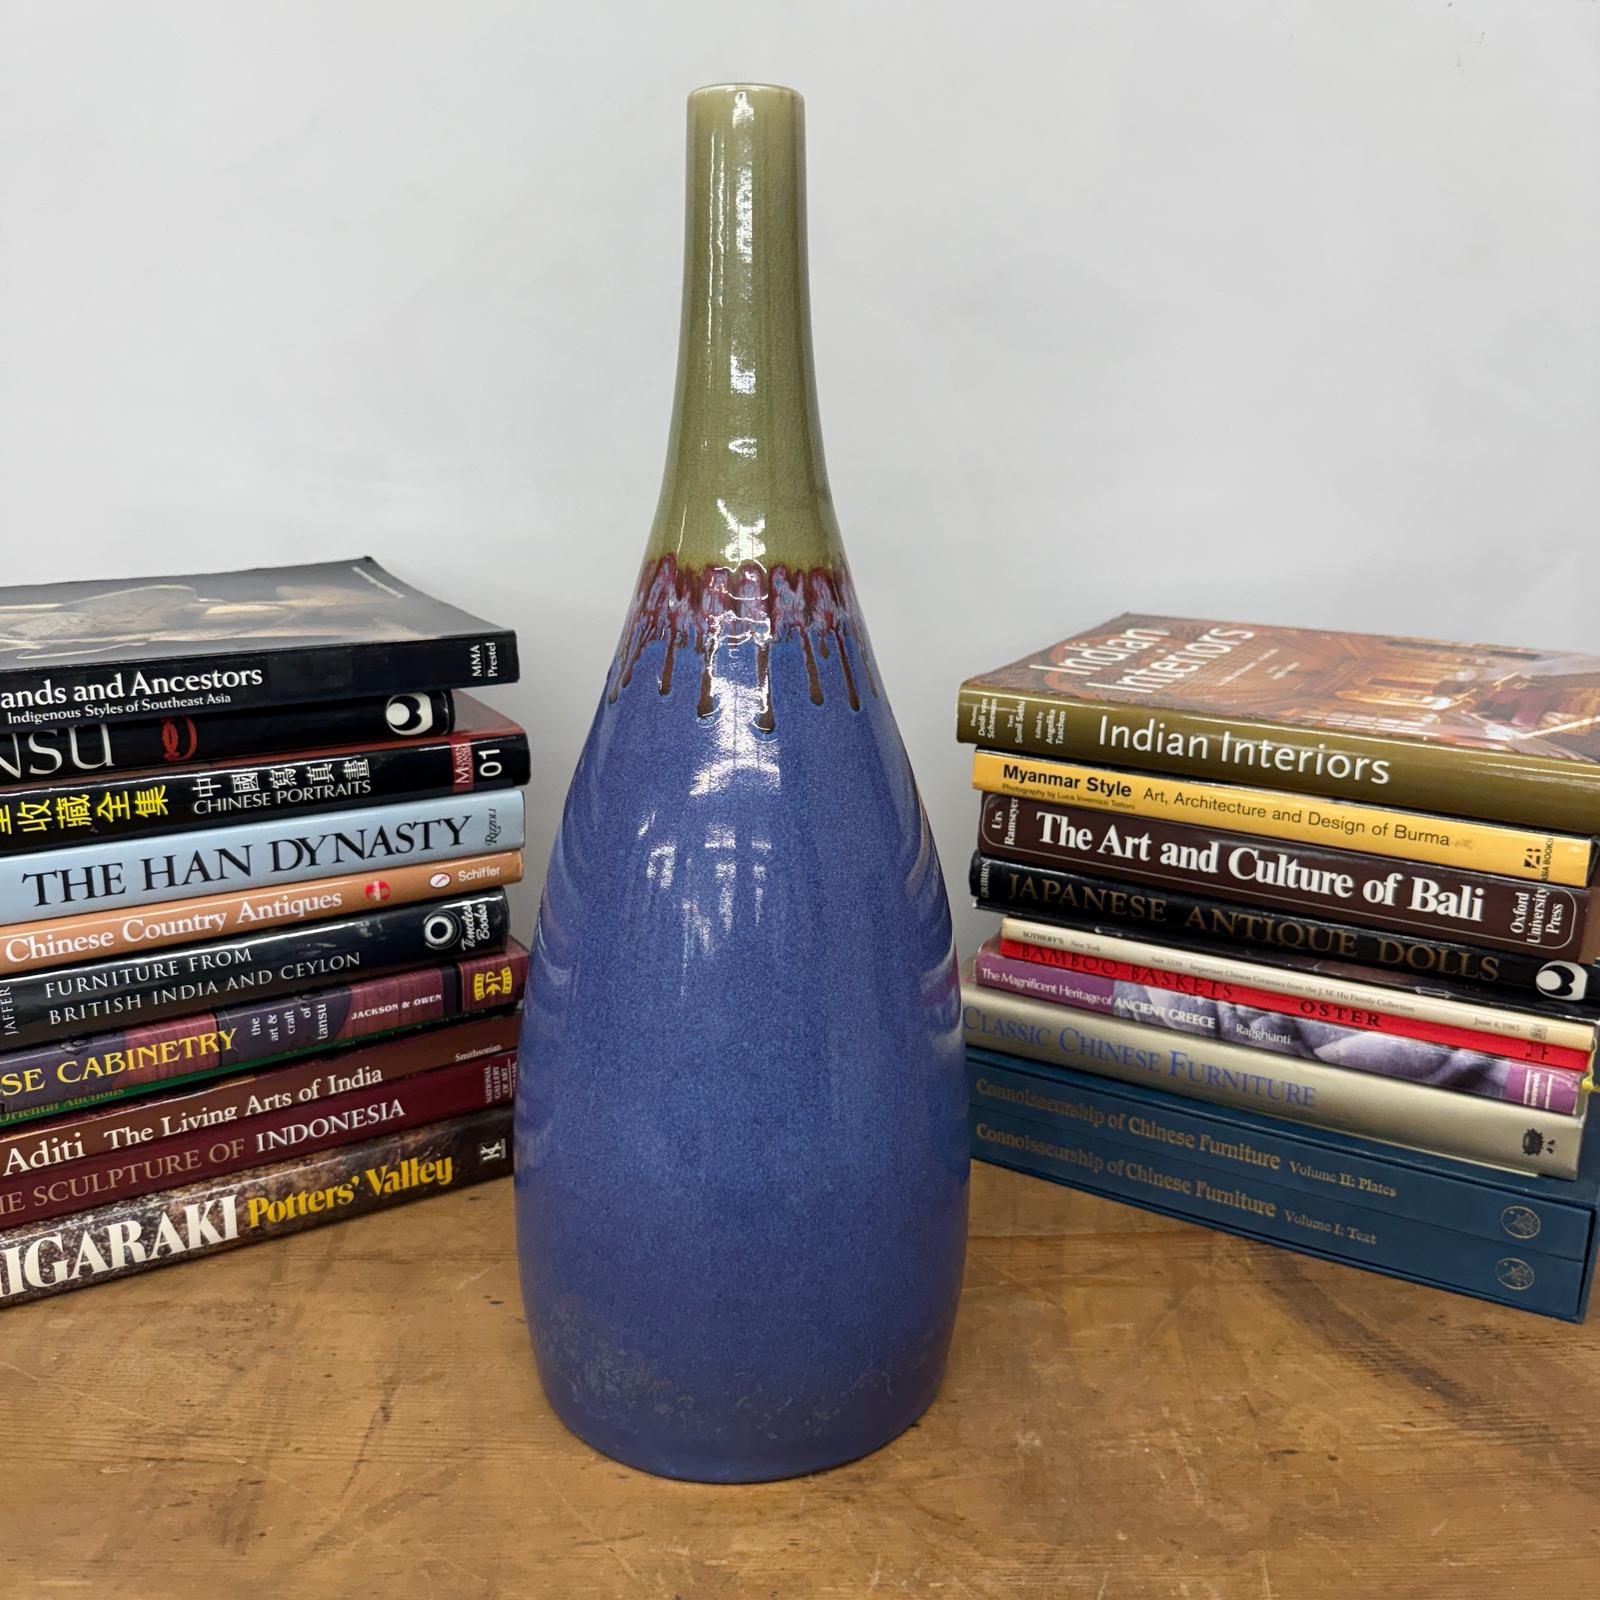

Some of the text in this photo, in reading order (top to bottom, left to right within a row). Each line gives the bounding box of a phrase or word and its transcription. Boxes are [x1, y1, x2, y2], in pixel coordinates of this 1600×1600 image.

[470, 644, 483, 677] MMA
[485, 642, 498, 677] Prestel
[1028, 627, 1171, 676] Indian
[1085, 627, 1255, 694] Interiors
[1, 668, 263, 709] ands and Ancestors
[8, 693, 231, 724] Indigenous Styles of Southeast Asia
[1056, 711, 1066, 744] Taschen
[478, 749, 502, 777] 01
[1099, 715, 1391, 785] Indian Interiors
[194, 780, 372, 815] CHINESE PORTRAITS
[1002, 783, 1045, 797] Photography
[1047, 790, 1056, 799] by
[1003, 764, 1450, 847] Myanmar Style Art, Architecture and Design of Burma
[991, 811, 1003, 829] Urs
[1004, 798, 1019, 845] Ramseyer
[22, 815, 473, 907] THE HAN DYNASTY
[1036, 811, 1485, 922] The Art and Culture of Bali
[1543, 838, 1554, 865] BOOKS
[458, 866, 500, 881] Schiffer
[6, 892, 342, 962] Chinese Country Antiques
[474, 903, 490, 940] Books
[1009, 873, 1499, 982] JAPANESE ANTIQUE DOLLS
[1510, 892, 1530, 933] Oxford
[1526, 887, 1550, 943] University
[1545, 903, 1563, 934] Press
[45, 948, 253, 999] FURNITURE FROM
[49, 952, 361, 1025] BRITISH INDIA AND CEYLON
[1022, 944, 1232, 998] BAMBOO BASKETS
[300, 1007, 312, 1018] of
[351, 994, 443, 1020] JACKSON & OWEN
[981, 968, 1216, 1029] The Magnificent Heritage of ANCIENT GREECE
[1300, 1000, 1380, 1027] OSTER
[251, 1017, 261, 1036] the
[268, 1014, 279, 1042] art &
[283, 1010, 295, 1034] craft
[317, 1003, 328, 1040] tansu
[1236, 1023, 1291, 1045] Ragghianti
[0, 1027, 237, 1097] SE CABINETRY
[455, 1044, 502, 1062] Smithsonian
[962, 1005, 1316, 1107] CLASSIC CHINESE FURNITURE
[2, 1066, 384, 1176] Aditi The Living Arts of India
[976, 1078, 1396, 1197] Connoisseurship of Chinese Furniture Volume II: Plates
[33, 1150, 203, 1208] SCULPTURE
[207, 1138, 246, 1163] OF
[255, 1098, 406, 1153] INDONESIA
[975, 1123, 1376, 1245] Connoisseurship of Chinese Furniture Volume I: Text
[0, 1195, 240, 1297] IGARAKI
[366, 1154, 453, 1197] Valley
